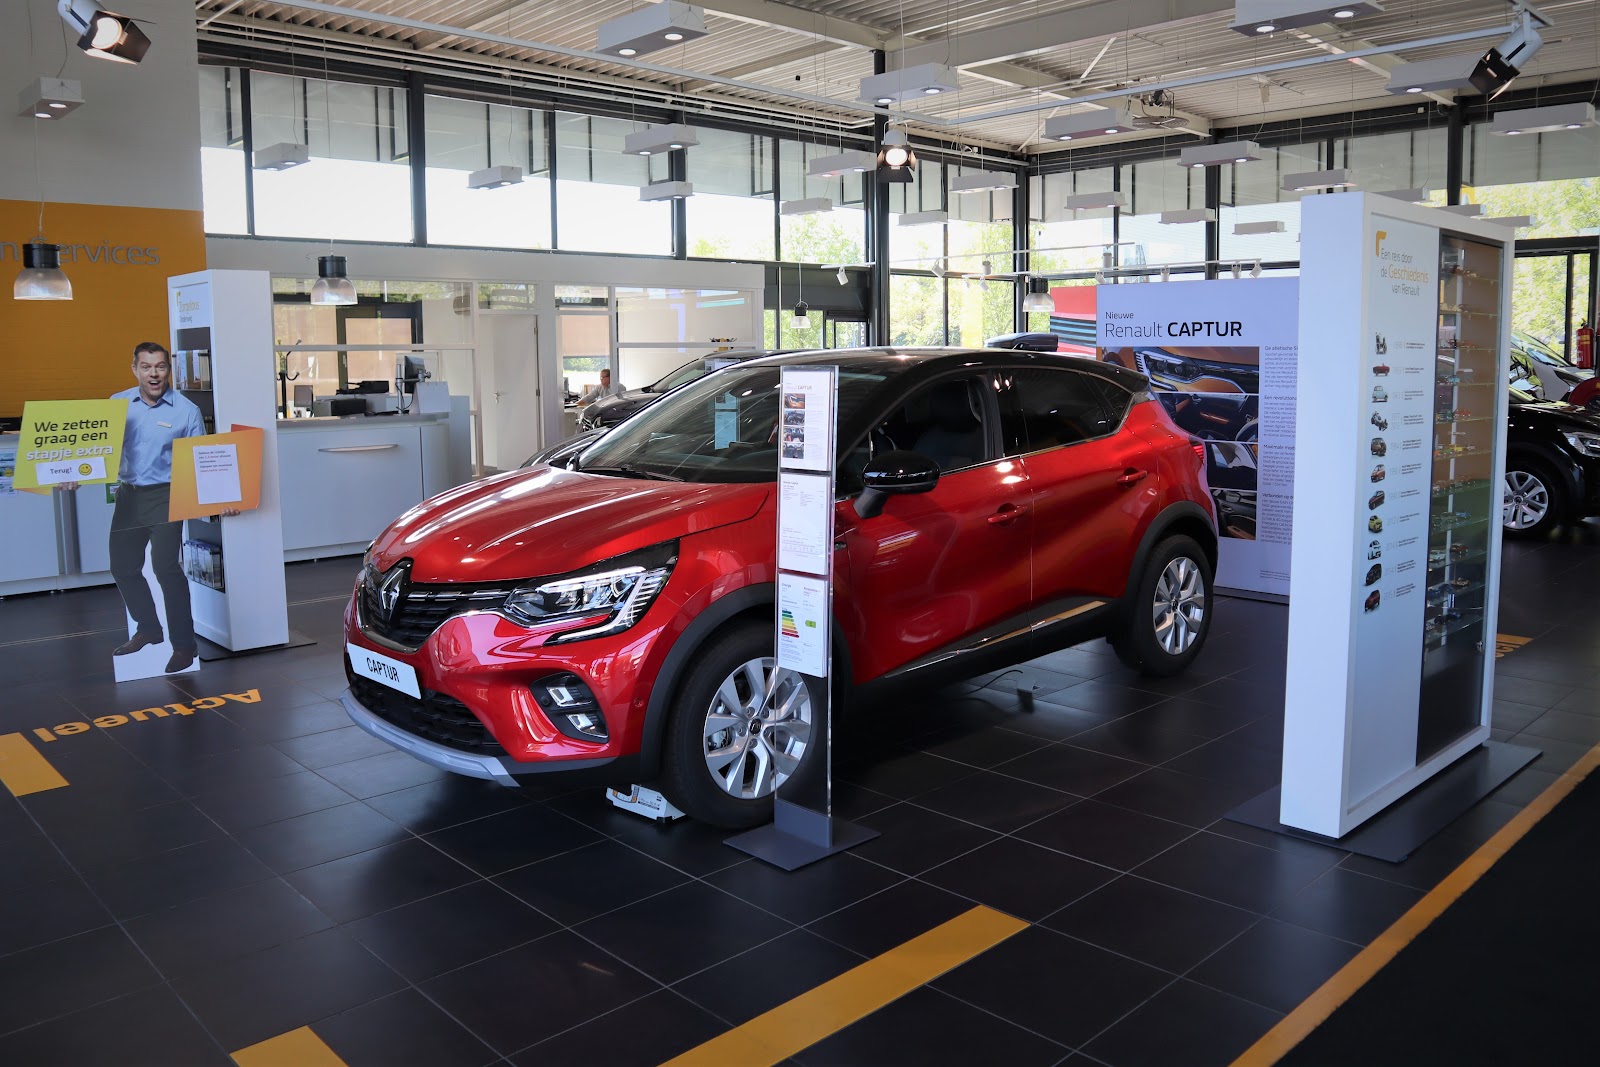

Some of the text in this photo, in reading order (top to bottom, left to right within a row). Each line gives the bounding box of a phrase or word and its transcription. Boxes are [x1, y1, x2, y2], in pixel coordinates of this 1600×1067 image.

[29, 237, 160, 265] ervices
[1402, 284, 1420, 296] Renault
[1105, 311, 1134, 319] Nieuwe
[1105, 321, 1242, 338] Renault CAPTUR
[34, 419, 109, 432] We zetten
[34, 431, 108, 448] graag een
[26, 444, 114, 462] stapje extra
[49, 466, 73, 475] Terug!
[366, 657, 400, 682] CAPTUR
[32, 688, 262, 742] Actueel
